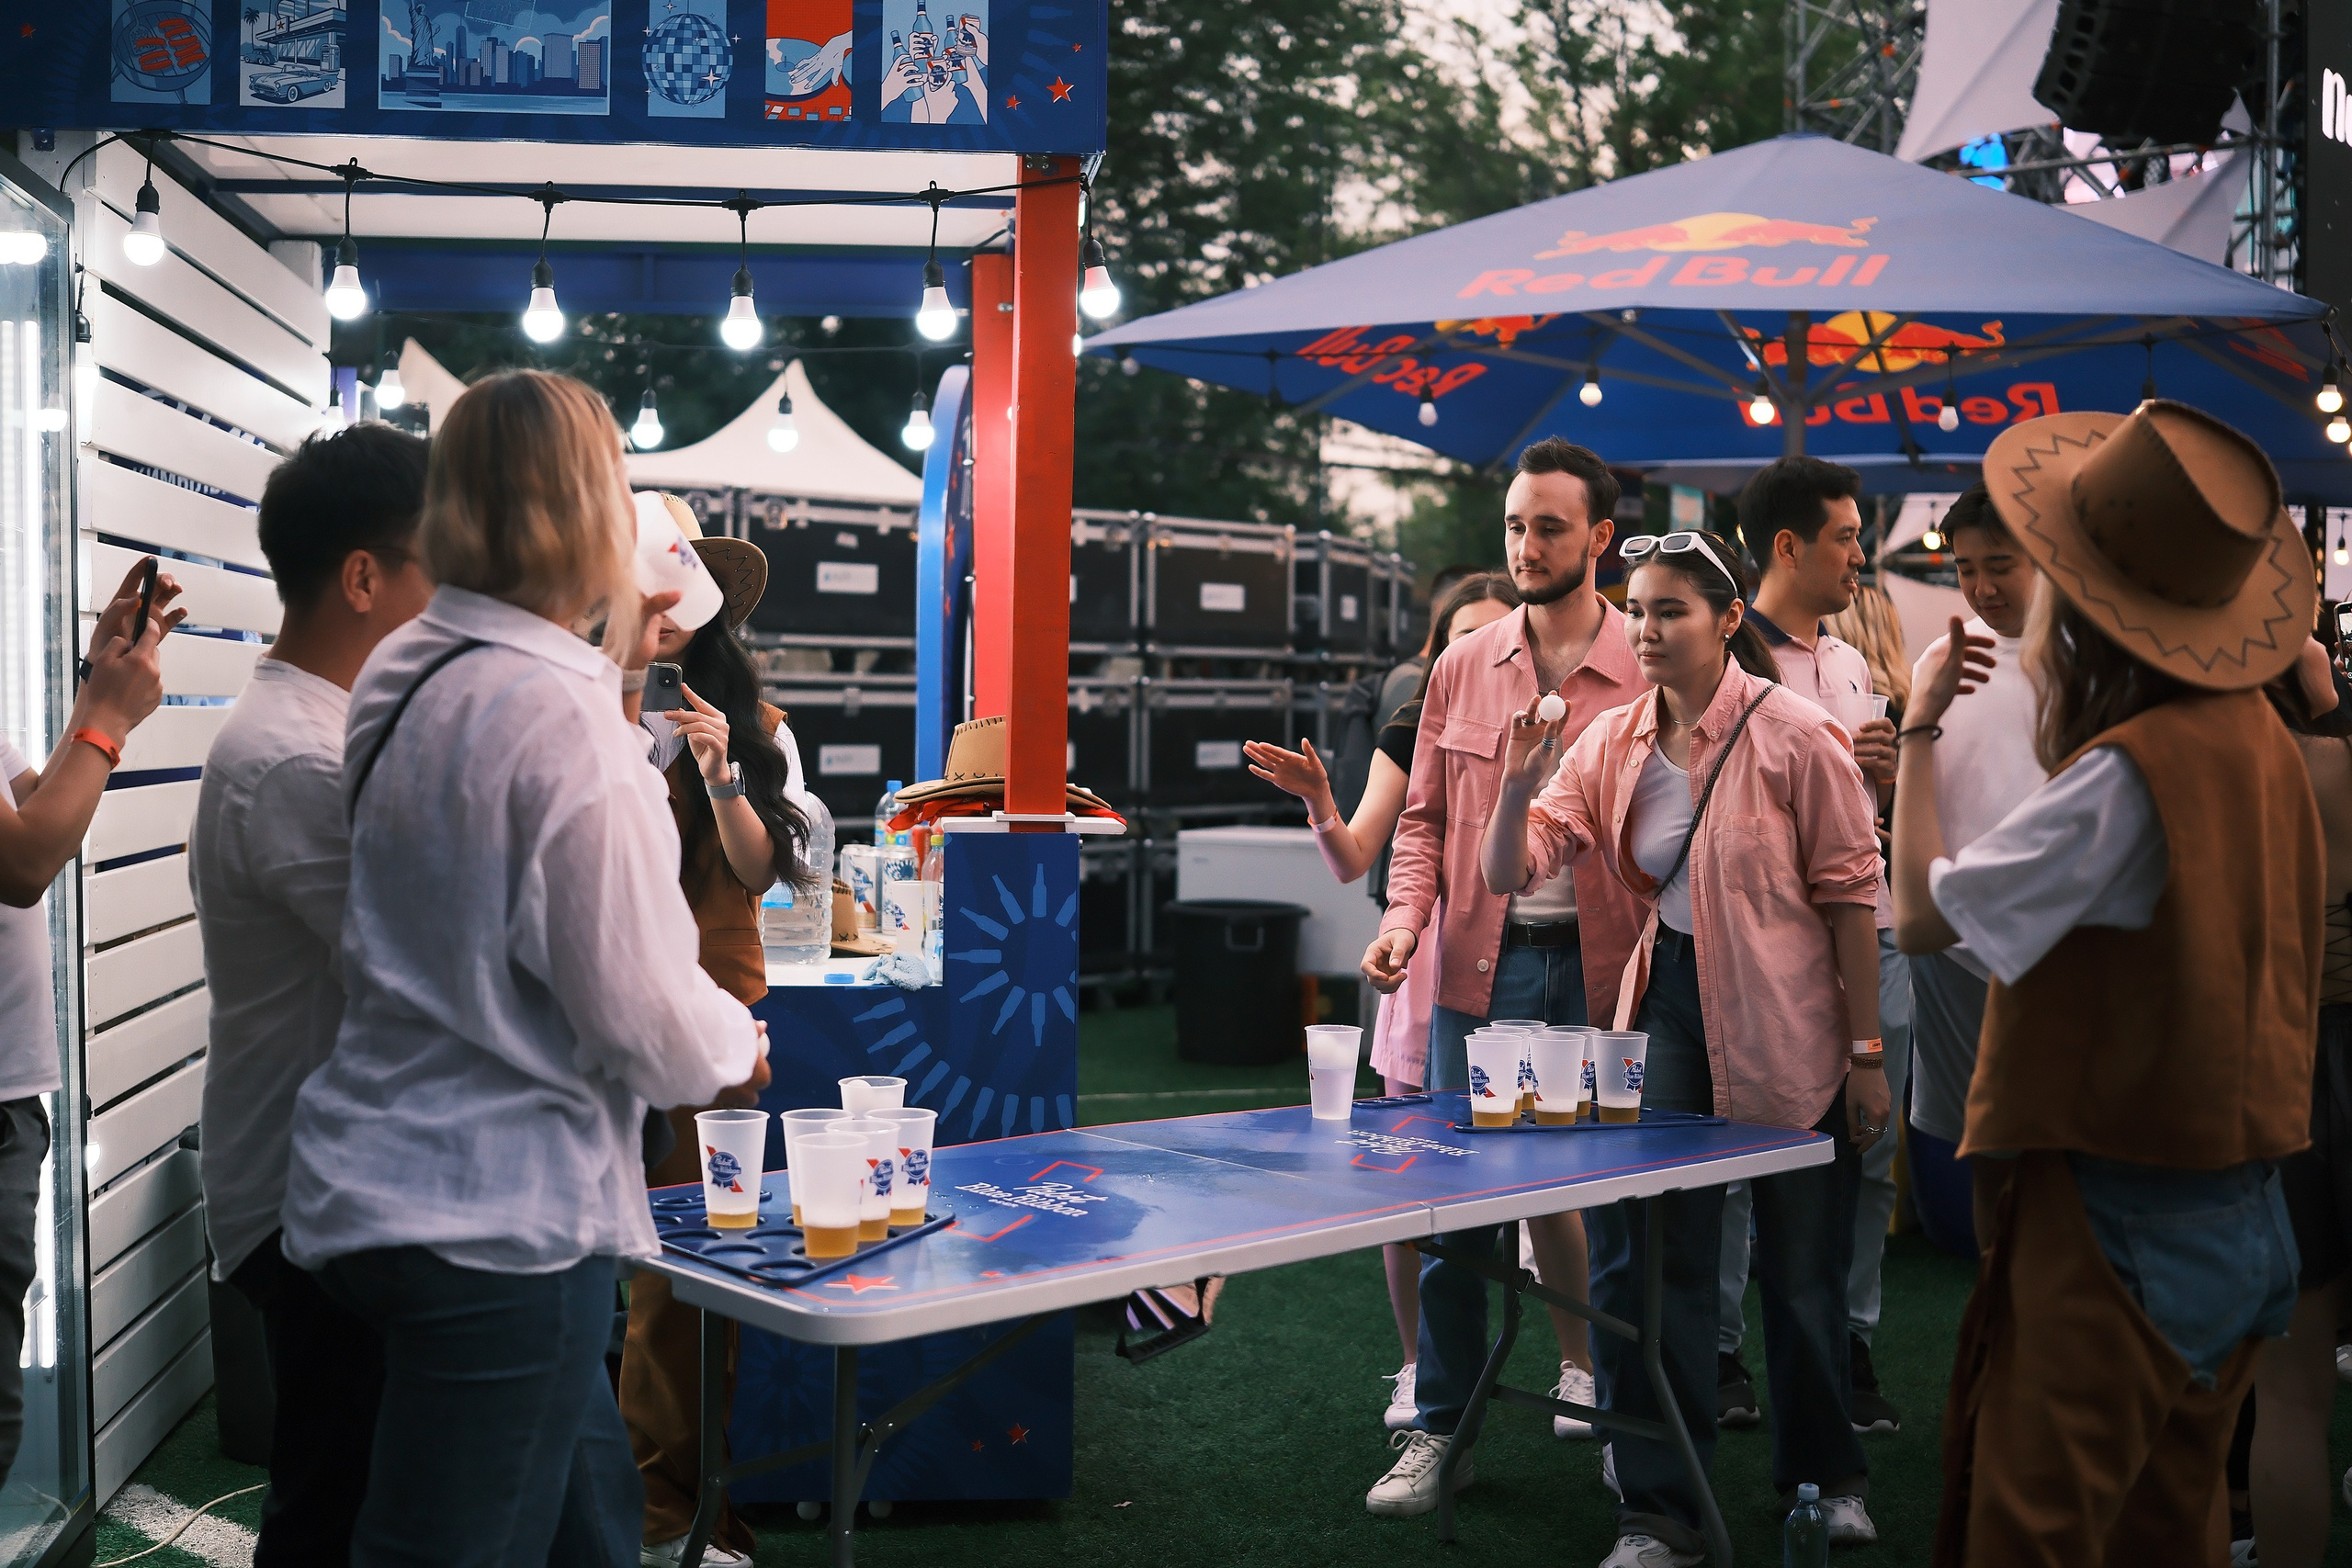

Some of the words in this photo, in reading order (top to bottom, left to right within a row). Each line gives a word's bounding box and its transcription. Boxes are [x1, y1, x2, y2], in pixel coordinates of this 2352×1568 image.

[1456, 255, 1670, 299] Red
[1670, 254, 1891, 288] Bull
[1003, 1193, 1090, 1217] Ribbon
